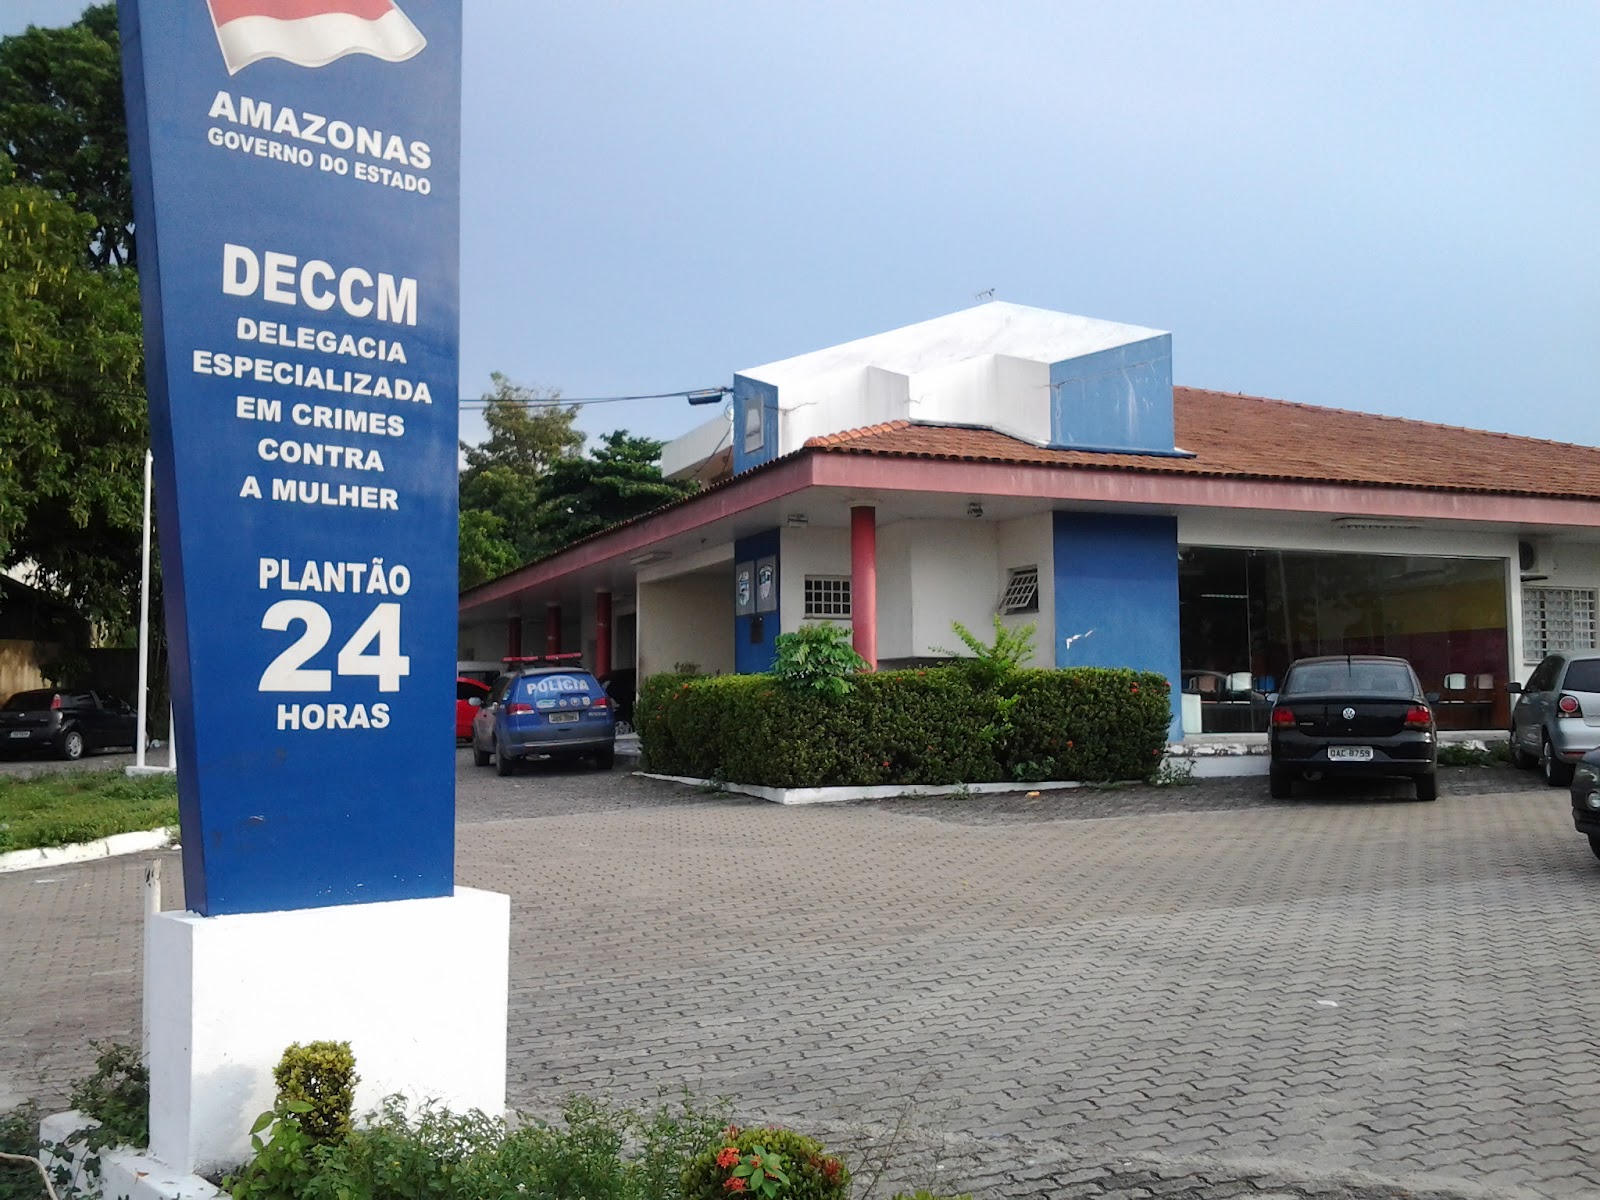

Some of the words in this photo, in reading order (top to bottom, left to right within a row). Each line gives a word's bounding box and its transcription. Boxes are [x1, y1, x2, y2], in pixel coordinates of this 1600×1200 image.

[207, 90, 432, 170] AMAZONAS
[207, 127, 314, 168] GOVERNO
[319, 152, 349, 176] DO
[354, 161, 432, 196] ESTADO
[222, 242, 418, 327] DECCM
[236, 317, 407, 364] DELEGACIA
[192, 350, 433, 404] ESPECIALIZADA
[236, 395, 282, 423] EM
[291, 403, 405, 437] CRIMES
[257, 438, 385, 472] CONTRA
[239, 475, 263, 499] A
[272, 478, 399, 511] MULHER
[259, 557, 411, 596] PLANTÃO
[258, 599, 410, 693] 24
[277, 703, 390, 730] HORAS
